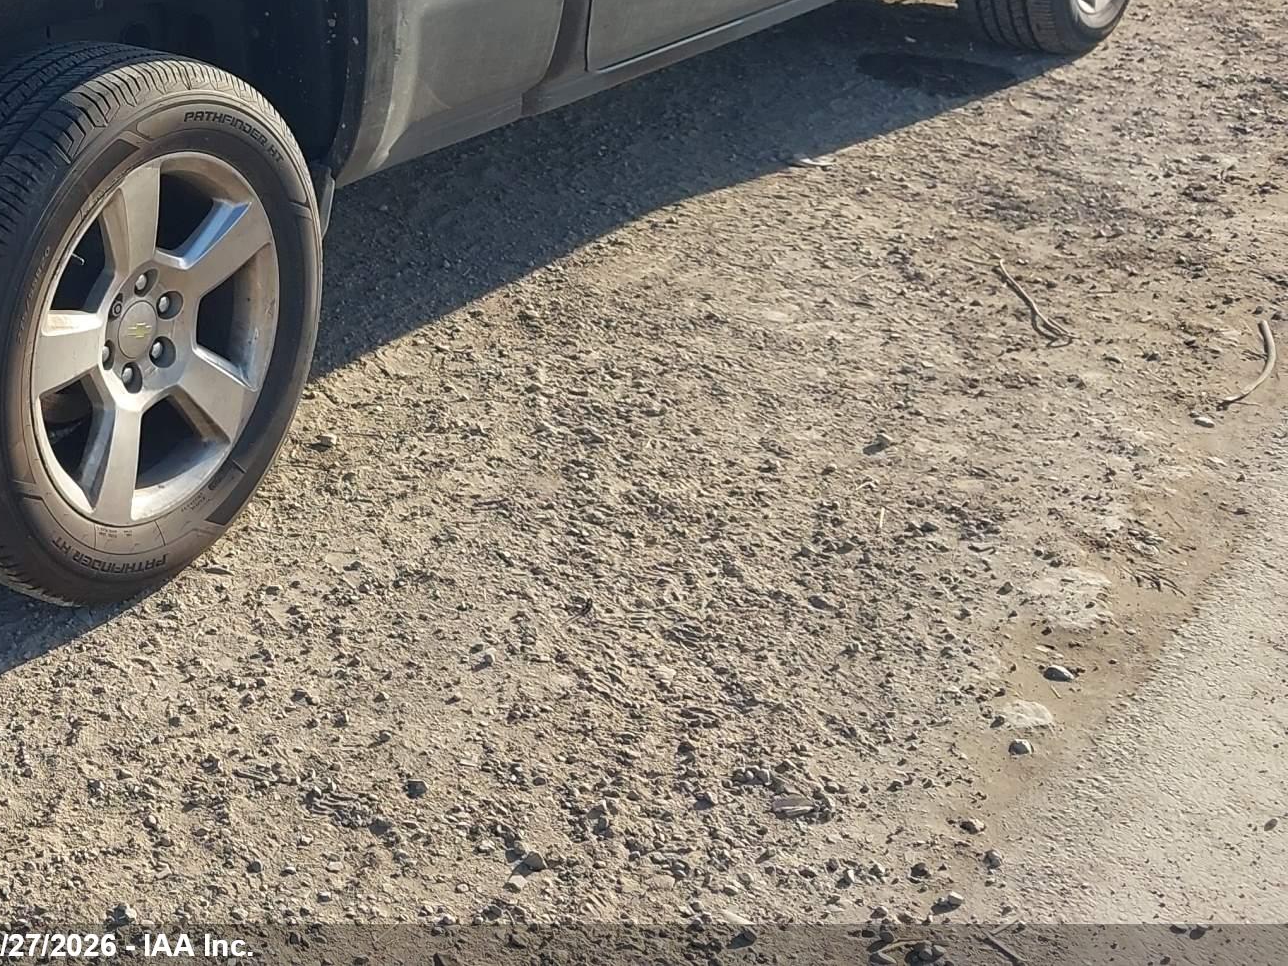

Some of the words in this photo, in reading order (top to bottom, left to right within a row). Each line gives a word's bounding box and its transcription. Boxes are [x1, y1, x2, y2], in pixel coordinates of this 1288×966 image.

[184, 111, 268, 146] PATHFINDER
[267, 141, 284, 163] HT
[51, 535, 72, 554] HT
[72, 552, 169, 574] PATHFINDER
